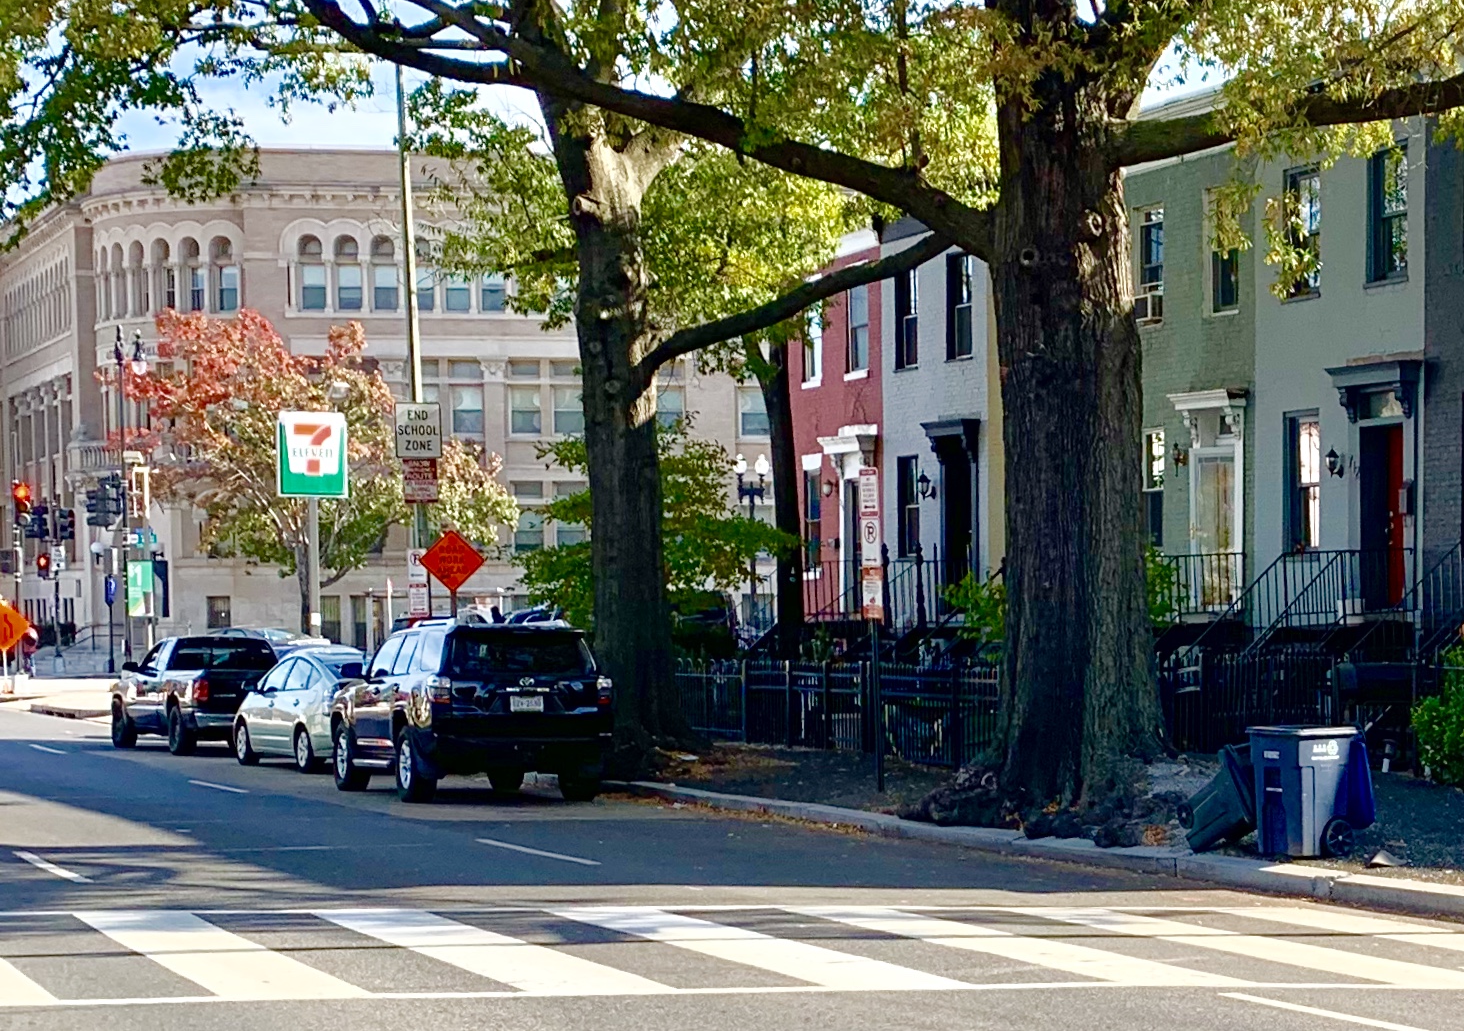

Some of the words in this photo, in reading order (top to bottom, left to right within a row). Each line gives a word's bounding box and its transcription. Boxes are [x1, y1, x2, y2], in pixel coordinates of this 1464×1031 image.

[407, 410, 428, 421] END
[397, 424, 439, 436] SCHOOL
[293, 423, 332, 474] 7
[405, 440, 433, 451] ZONE
